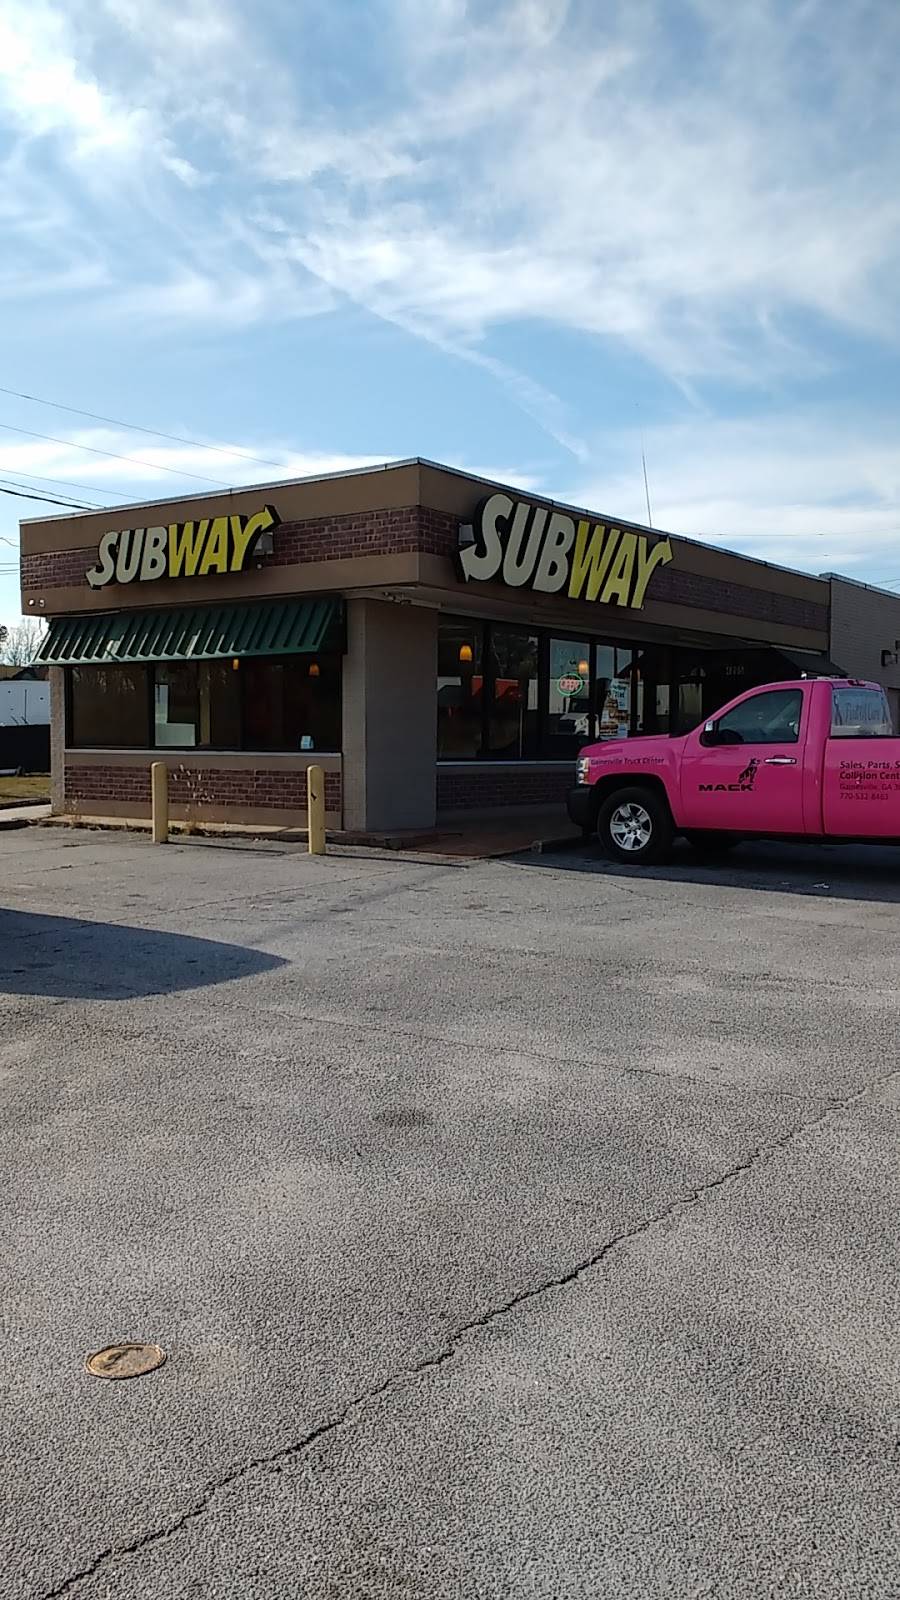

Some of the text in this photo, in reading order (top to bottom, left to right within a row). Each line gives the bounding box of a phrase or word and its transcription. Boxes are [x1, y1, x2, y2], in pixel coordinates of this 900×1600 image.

[85, 505, 276, 588] SUBWAY
[459, 493, 673, 610] SUBWAY
[839, 760, 866, 770] Sales,
[867, 760, 893, 770] Parts,
[839, 770, 878, 780] Collision
[698, 784, 753, 792] MACK
